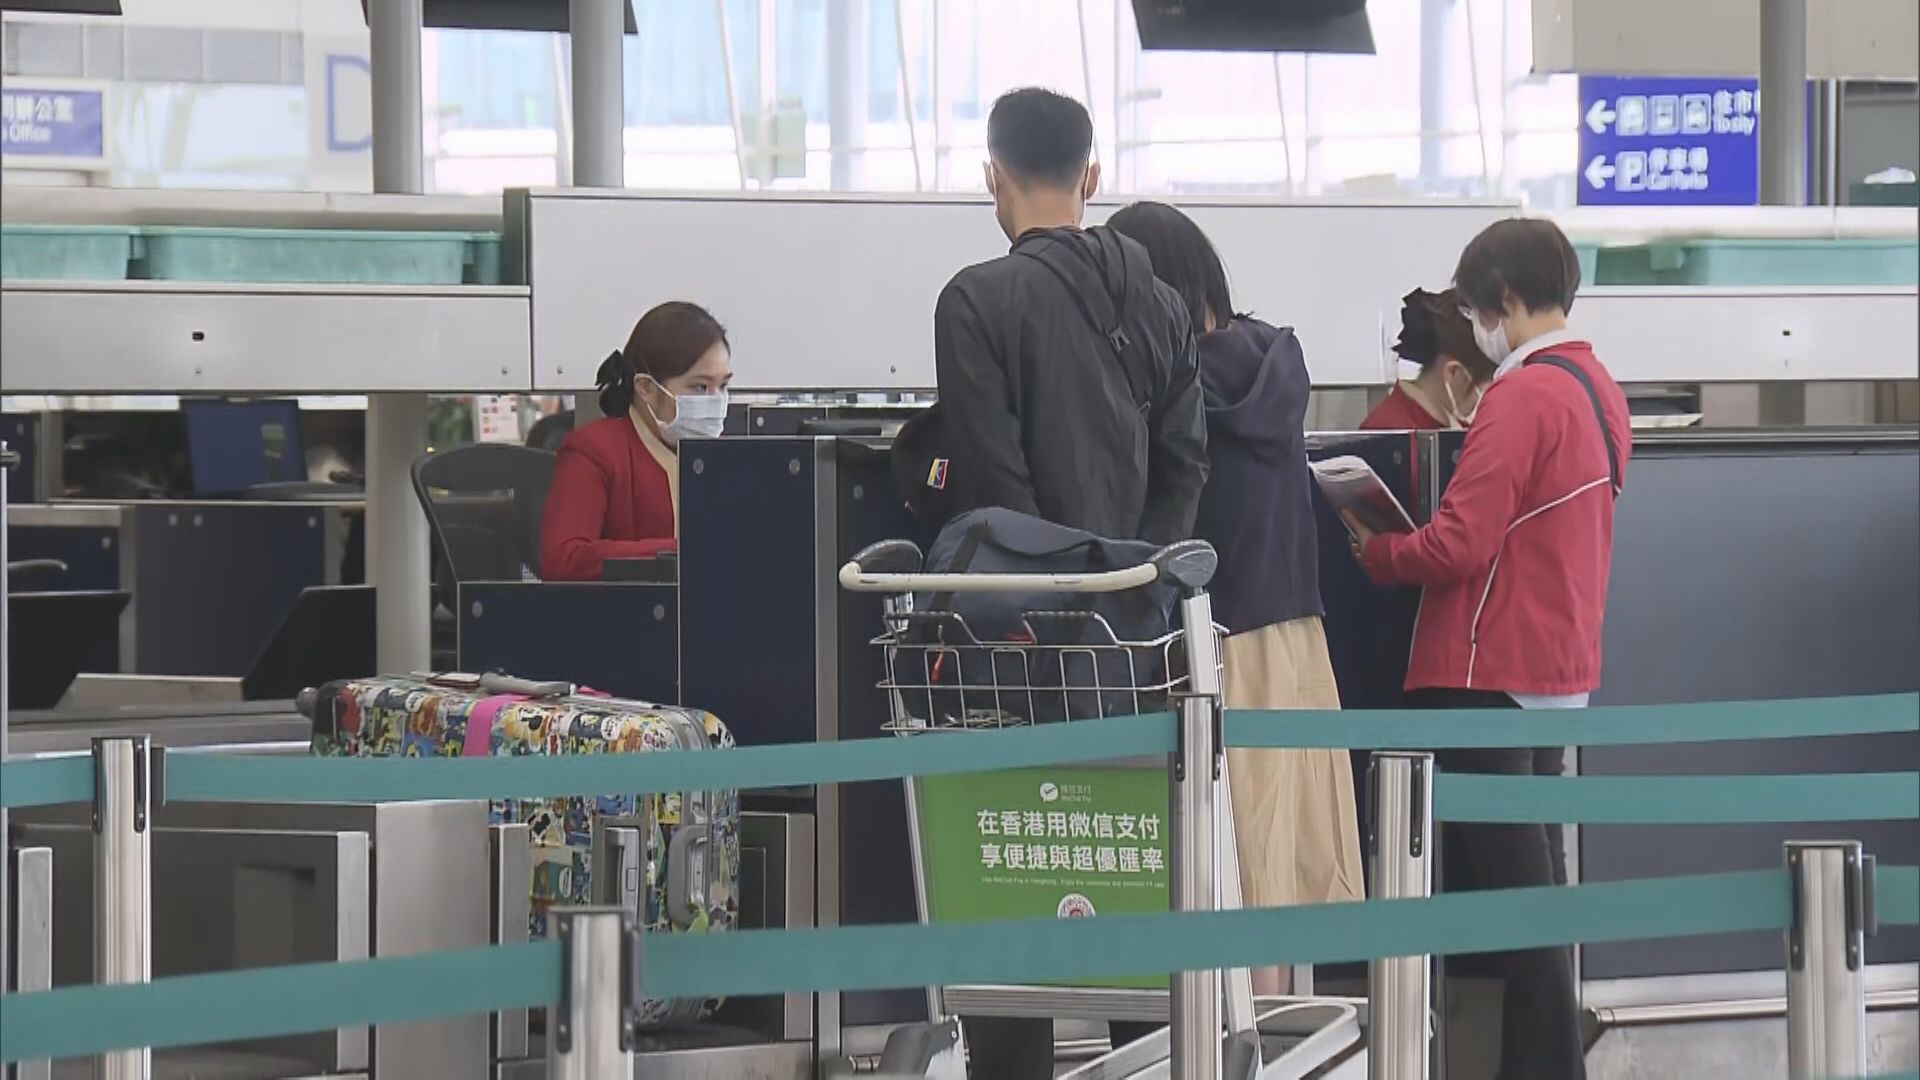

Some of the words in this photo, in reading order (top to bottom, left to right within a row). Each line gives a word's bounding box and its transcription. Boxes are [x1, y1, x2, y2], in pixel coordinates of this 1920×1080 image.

[977, 809, 1160, 840] 在香港用微信支付
[980, 843, 1165, 874] 享便捷與超優匯率
